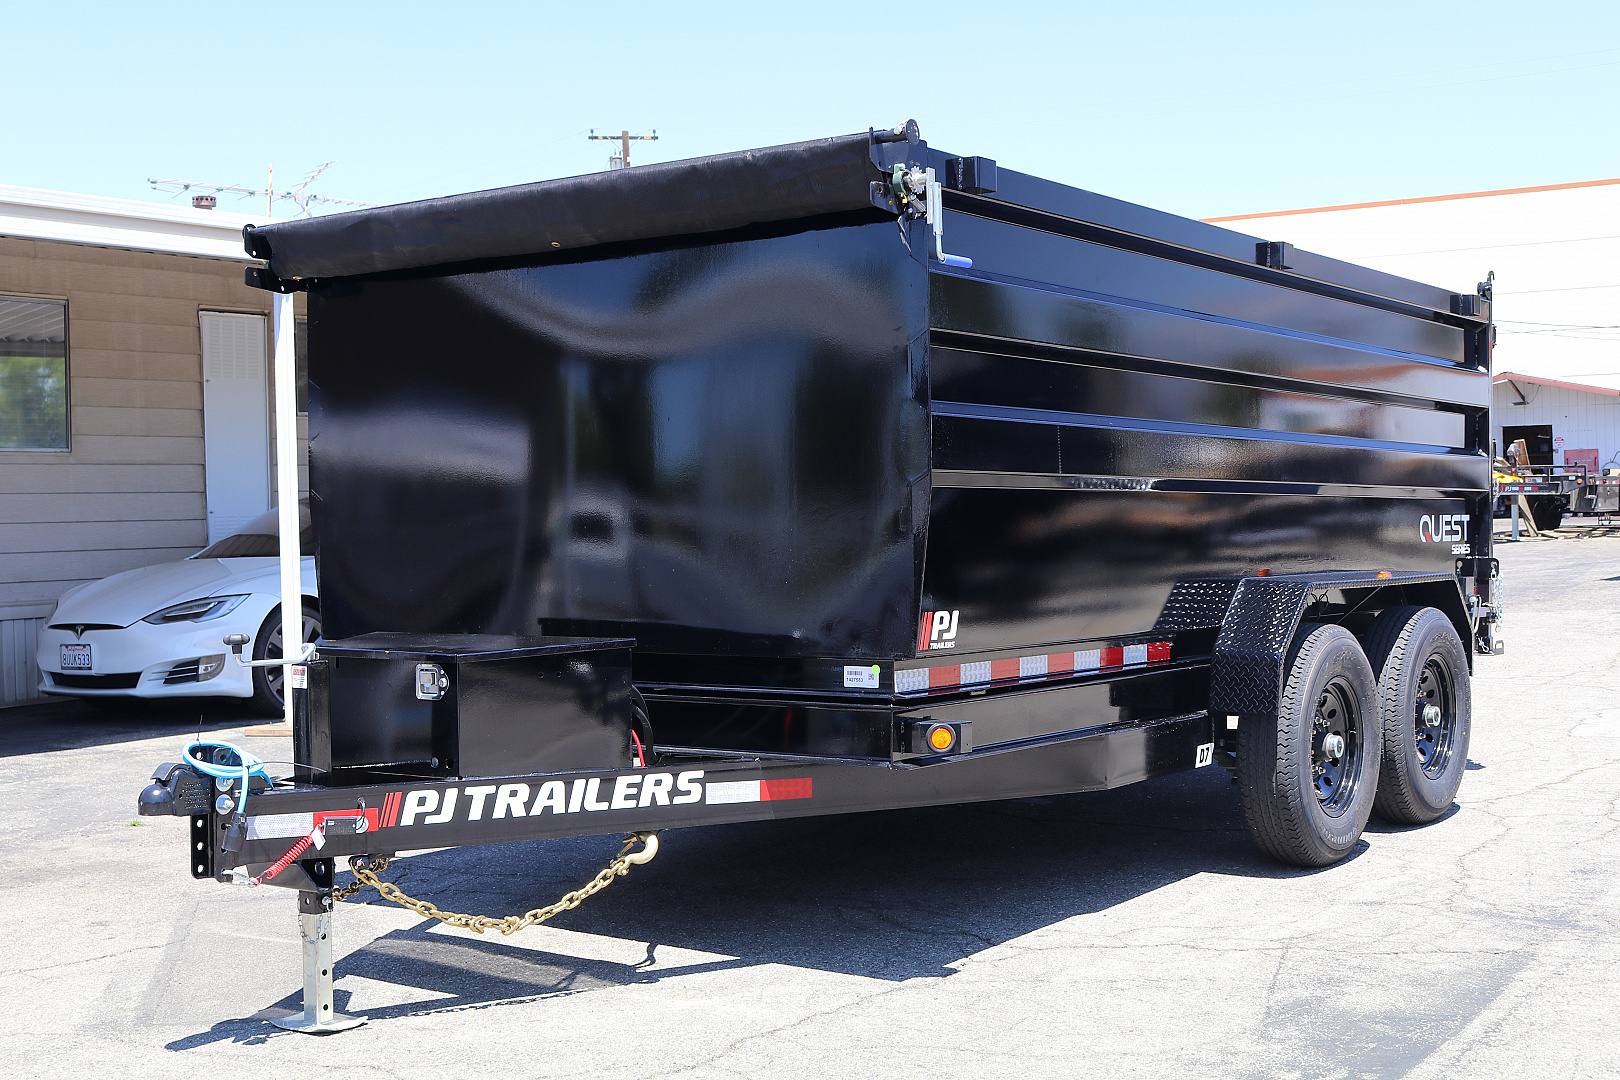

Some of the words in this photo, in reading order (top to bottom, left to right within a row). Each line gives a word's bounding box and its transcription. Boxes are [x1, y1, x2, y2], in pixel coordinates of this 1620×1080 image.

[1419, 514, 1470, 543] QUEST
[931, 610, 960, 641] PJ
[929, 641, 956, 650] TRAILERS
[1199, 746, 1210, 764] D7
[400, 788, 458, 826] PJ
[465, 770, 704, 821] TRAILERS
